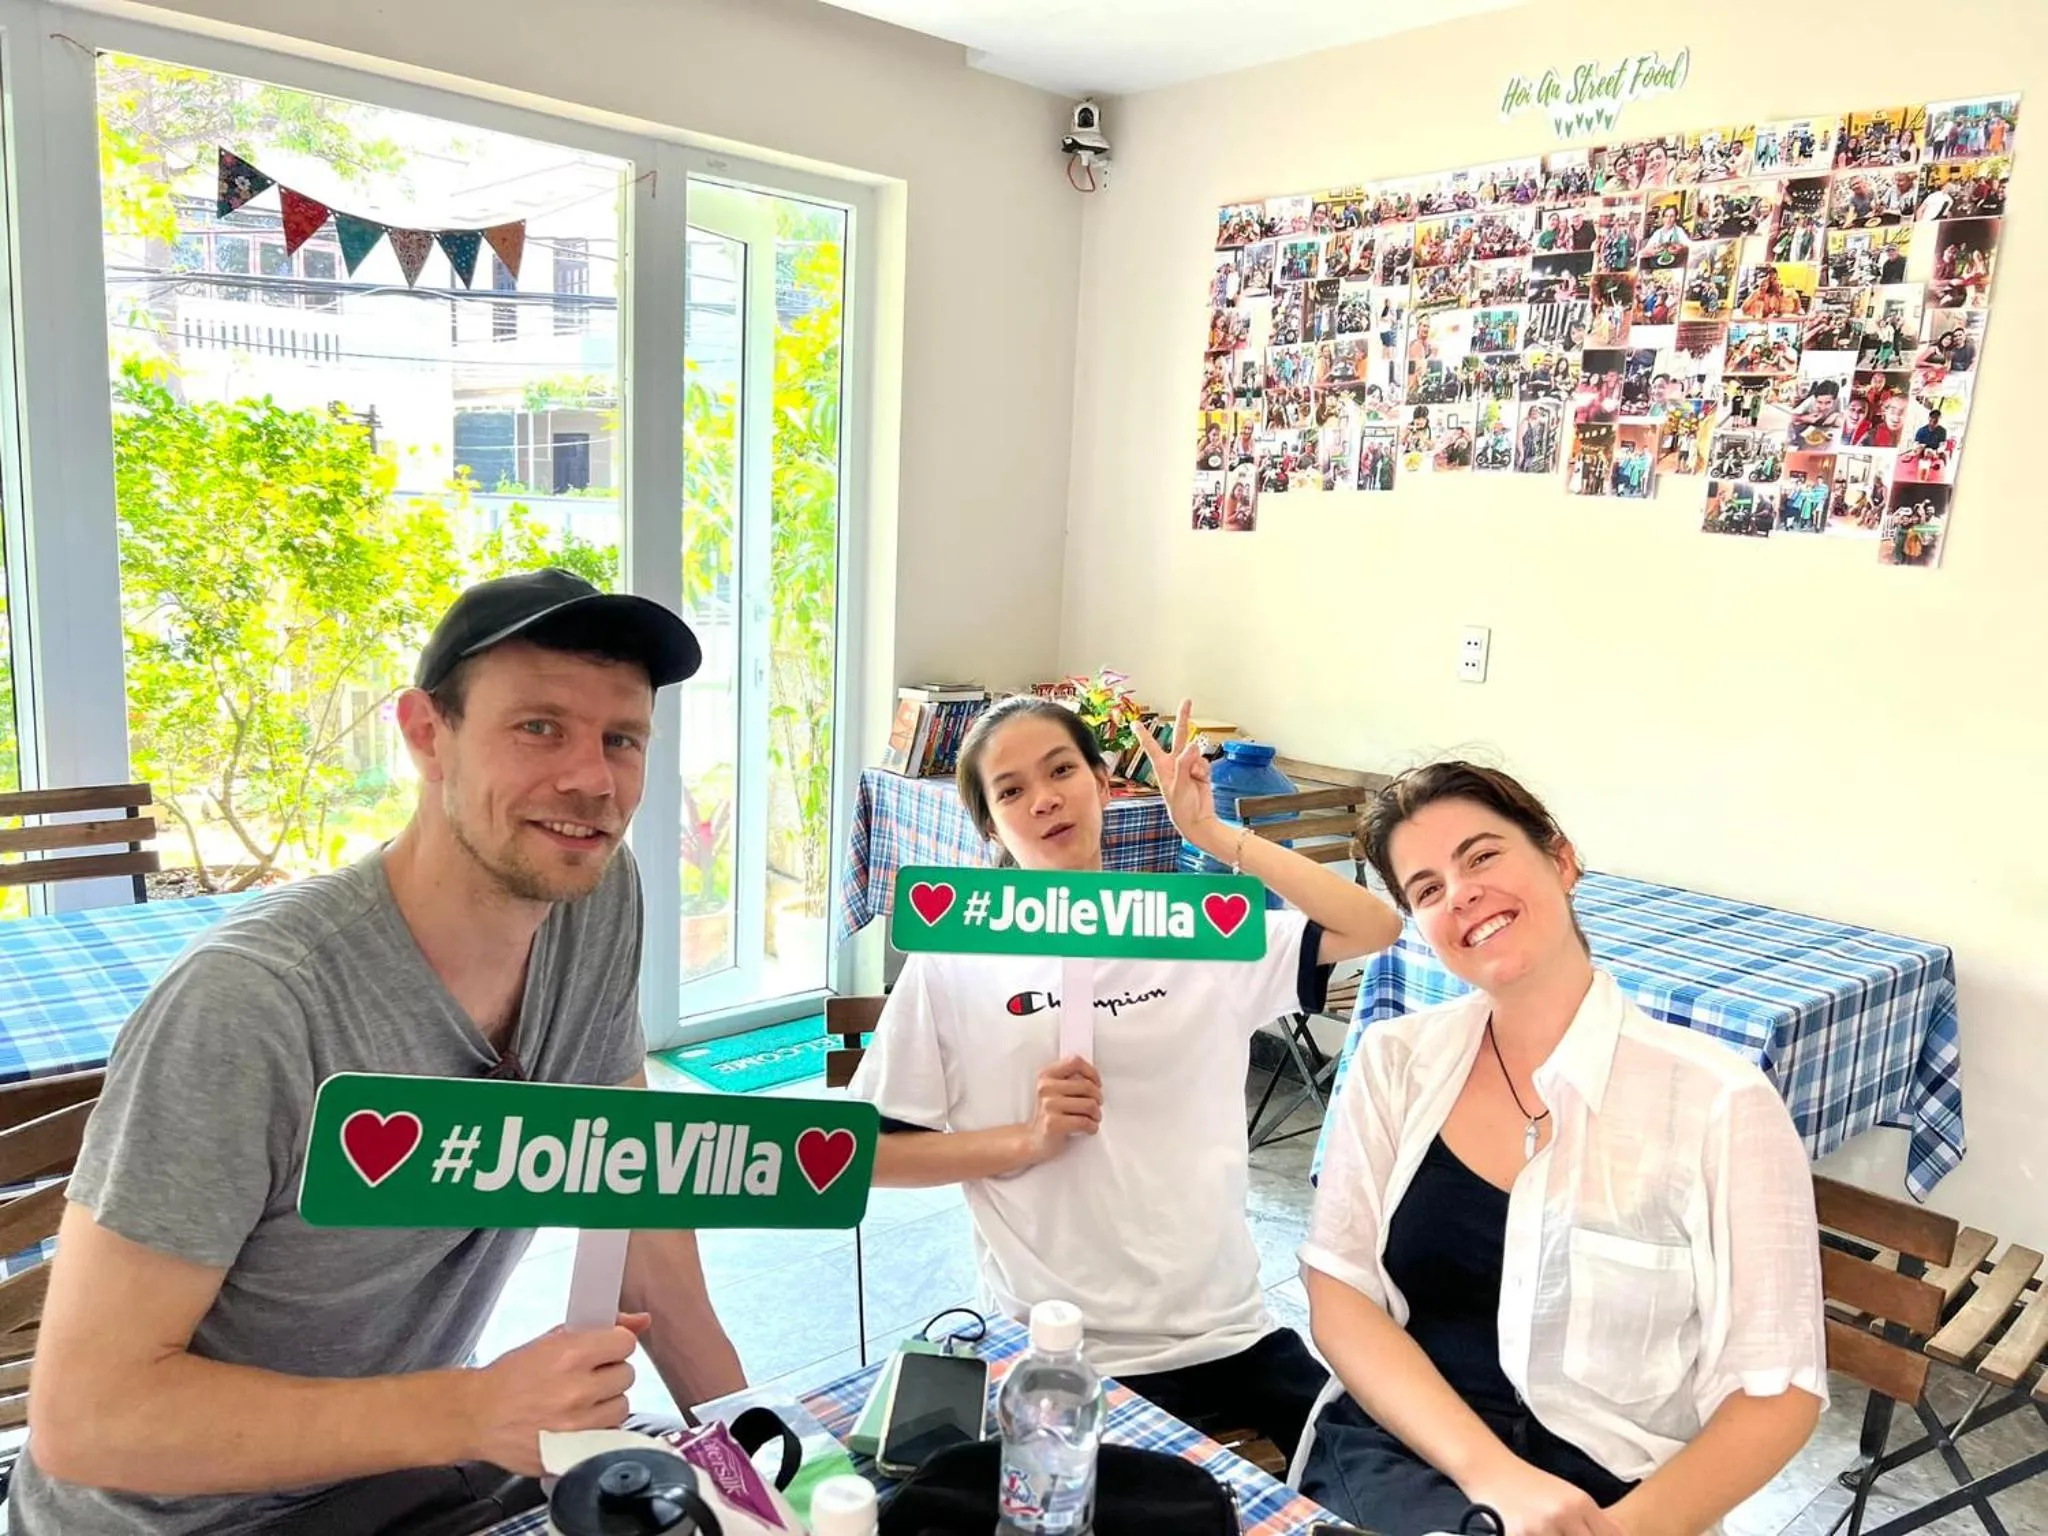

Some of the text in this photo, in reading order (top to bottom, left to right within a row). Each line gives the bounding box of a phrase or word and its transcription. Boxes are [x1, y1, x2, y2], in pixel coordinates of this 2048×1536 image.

[1565, 58, 1629, 104] Street
[1628, 52, 1686, 95] Food
[962, 884, 1195, 939] #JolieVilla
[1006, 988, 1168, 1017] Chmpion
[711, 1037, 837, 1073] ELCOME
[431, 1115, 783, 1197] #JolieVilla
